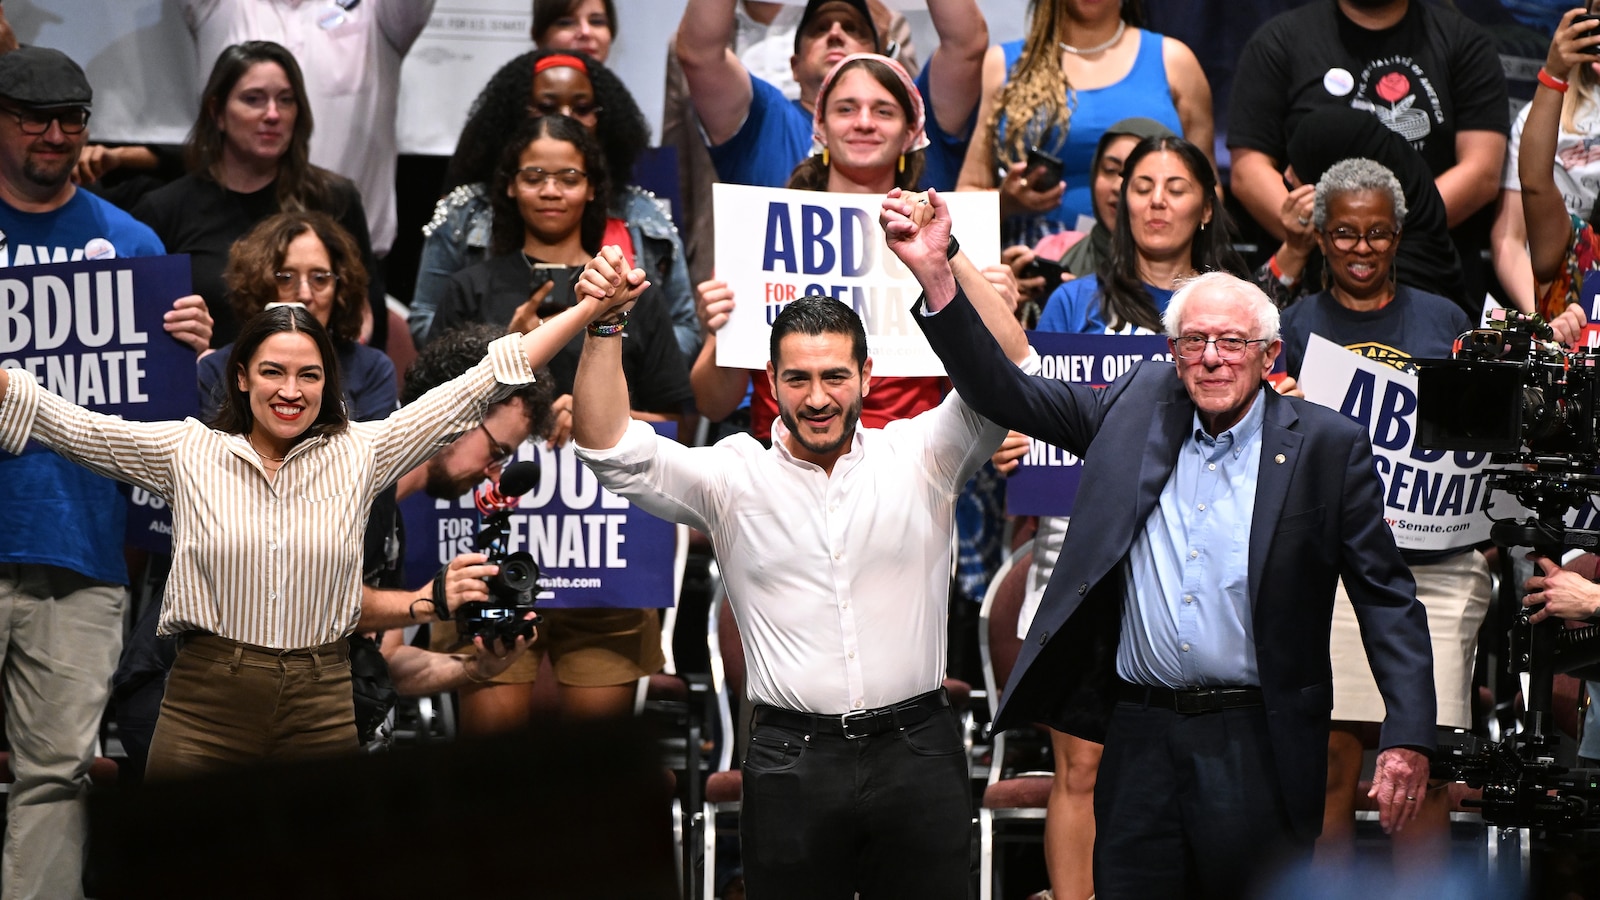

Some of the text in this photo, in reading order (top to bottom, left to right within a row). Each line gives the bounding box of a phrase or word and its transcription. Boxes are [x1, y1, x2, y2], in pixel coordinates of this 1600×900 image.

[762, 202, 917, 280] ABD
[0, 269, 148, 354] BDUL
[765, 283, 797, 303] FOR
[0, 350, 149, 405] ENATE
[1038, 354, 1095, 382] ONEY
[1339, 368, 1487, 469] AB
[438, 518, 474, 541] FOR
[480, 514, 627, 568] ENATE
[1384, 517, 1470, 533] orSenate.com
